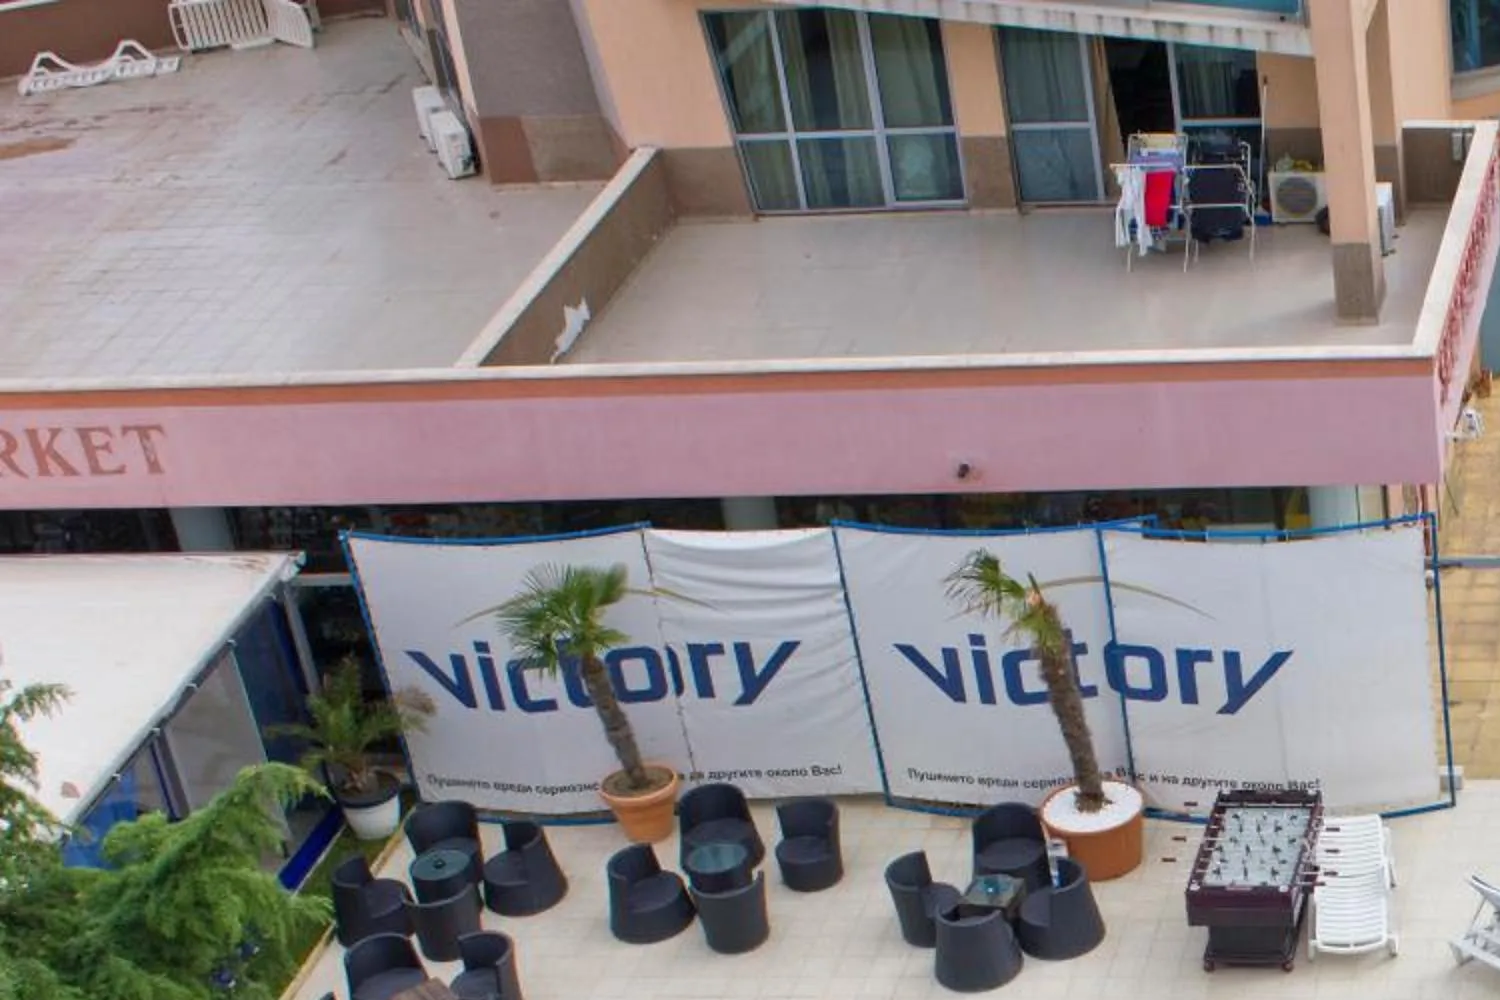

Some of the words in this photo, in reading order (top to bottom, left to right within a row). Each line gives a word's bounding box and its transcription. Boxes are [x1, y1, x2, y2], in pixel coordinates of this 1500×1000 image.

[812, 763, 842, 777] Вас!
[907, 767, 974, 785] Пушенето
[978, 777, 1019, 789] вреди
